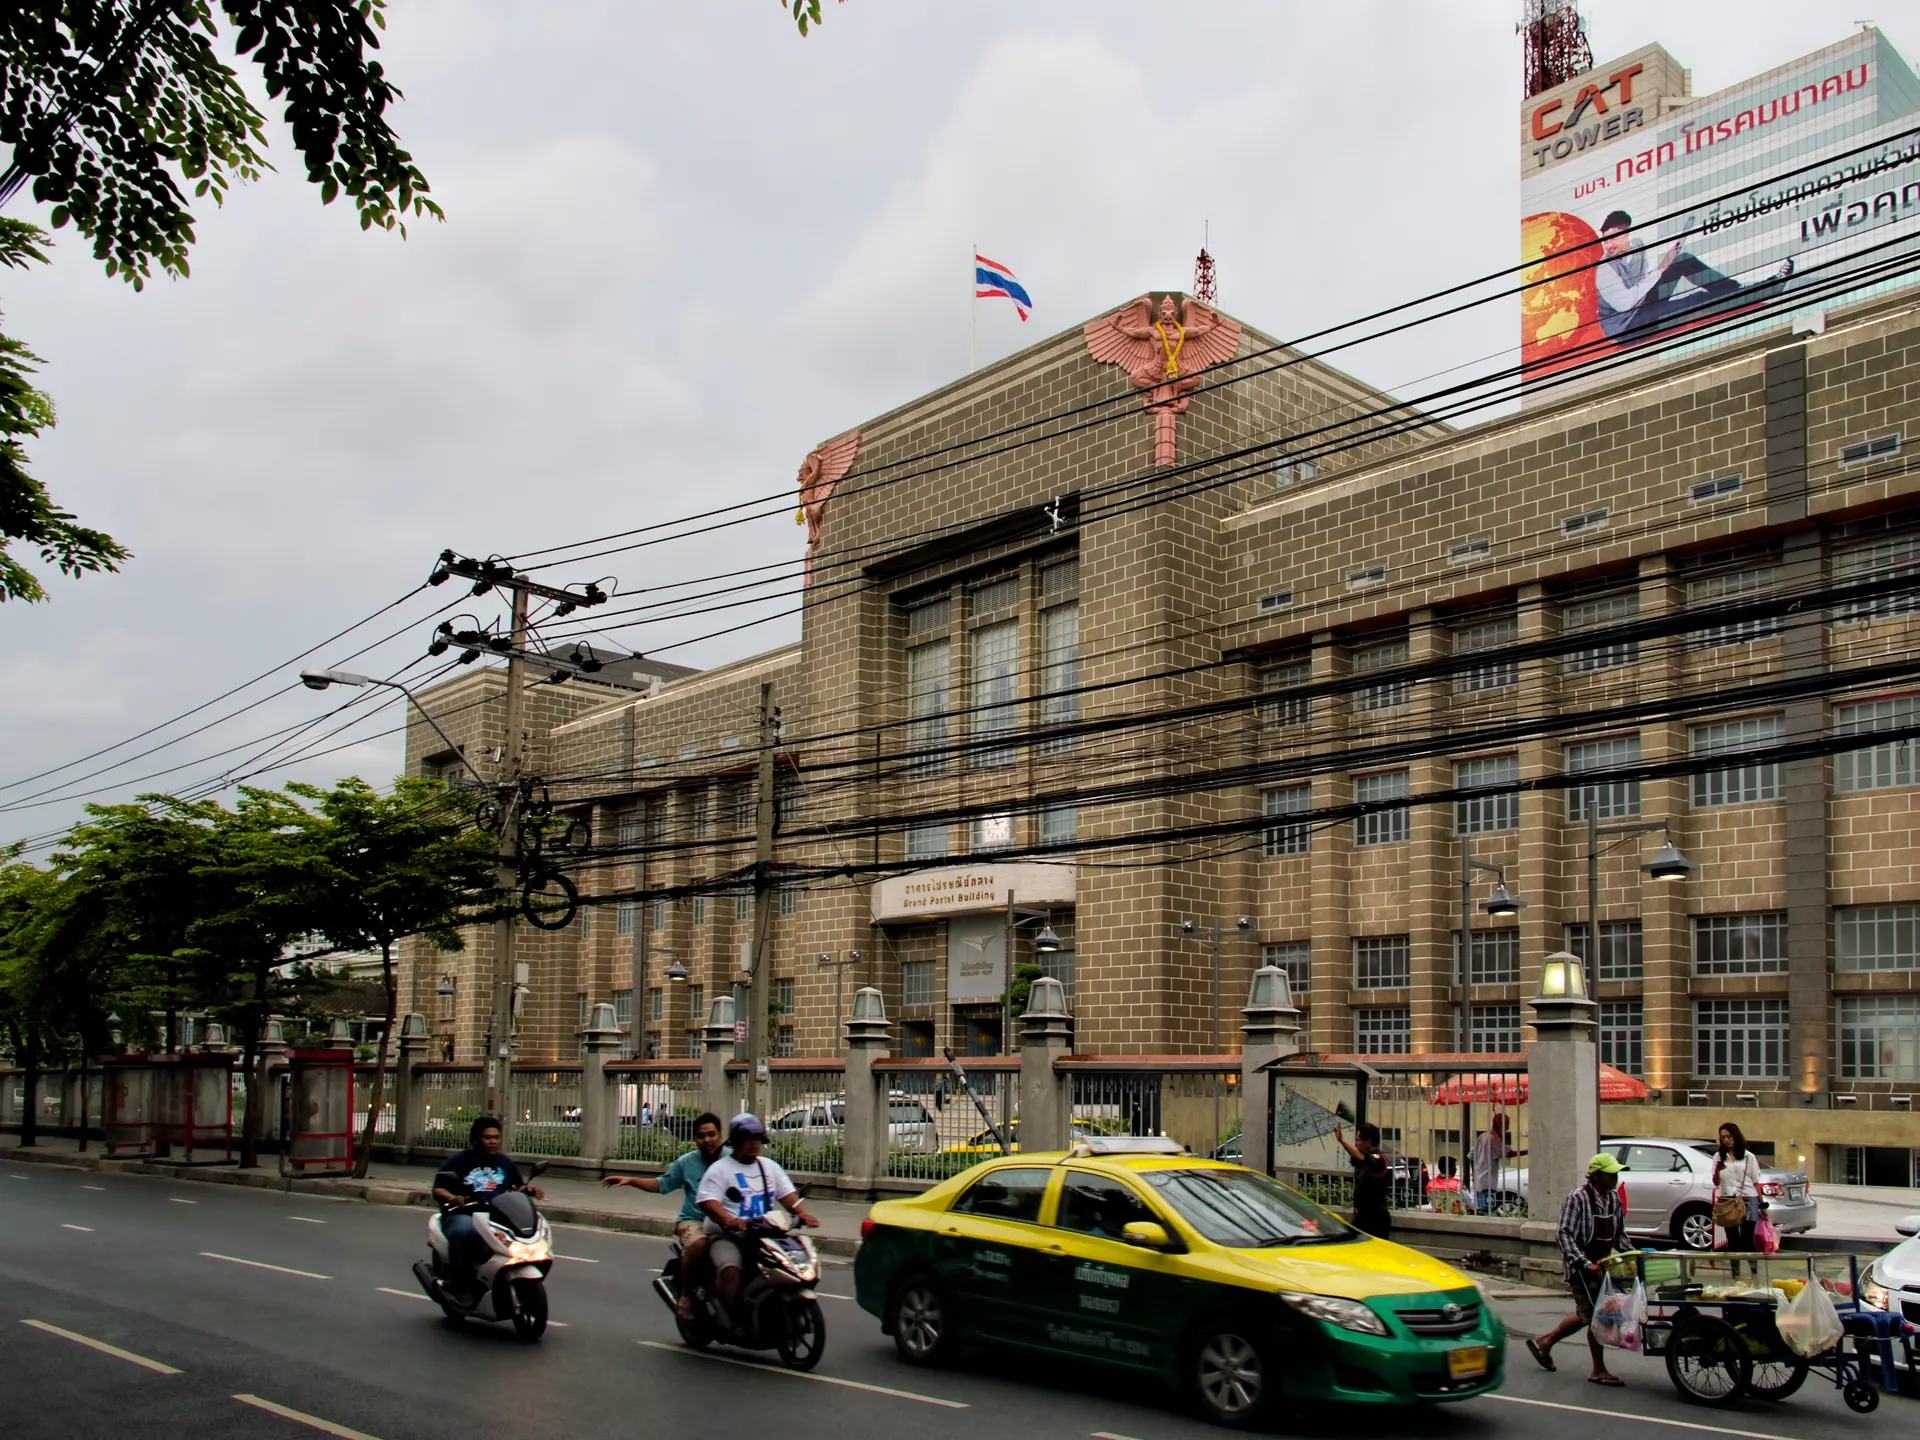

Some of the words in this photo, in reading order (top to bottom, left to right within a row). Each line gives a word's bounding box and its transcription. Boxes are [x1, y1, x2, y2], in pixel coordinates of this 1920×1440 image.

[1532, 63, 1643, 141] CAT
[1615, 141, 1674, 183] กสท
[1680, 63, 1868, 155] โทรคมนาคม
[1533, 107, 1643, 168] TOWER
[904, 897, 926, 908] Grand
[930, 894, 954, 905] Postal
[958, 891, 995, 902] Building
